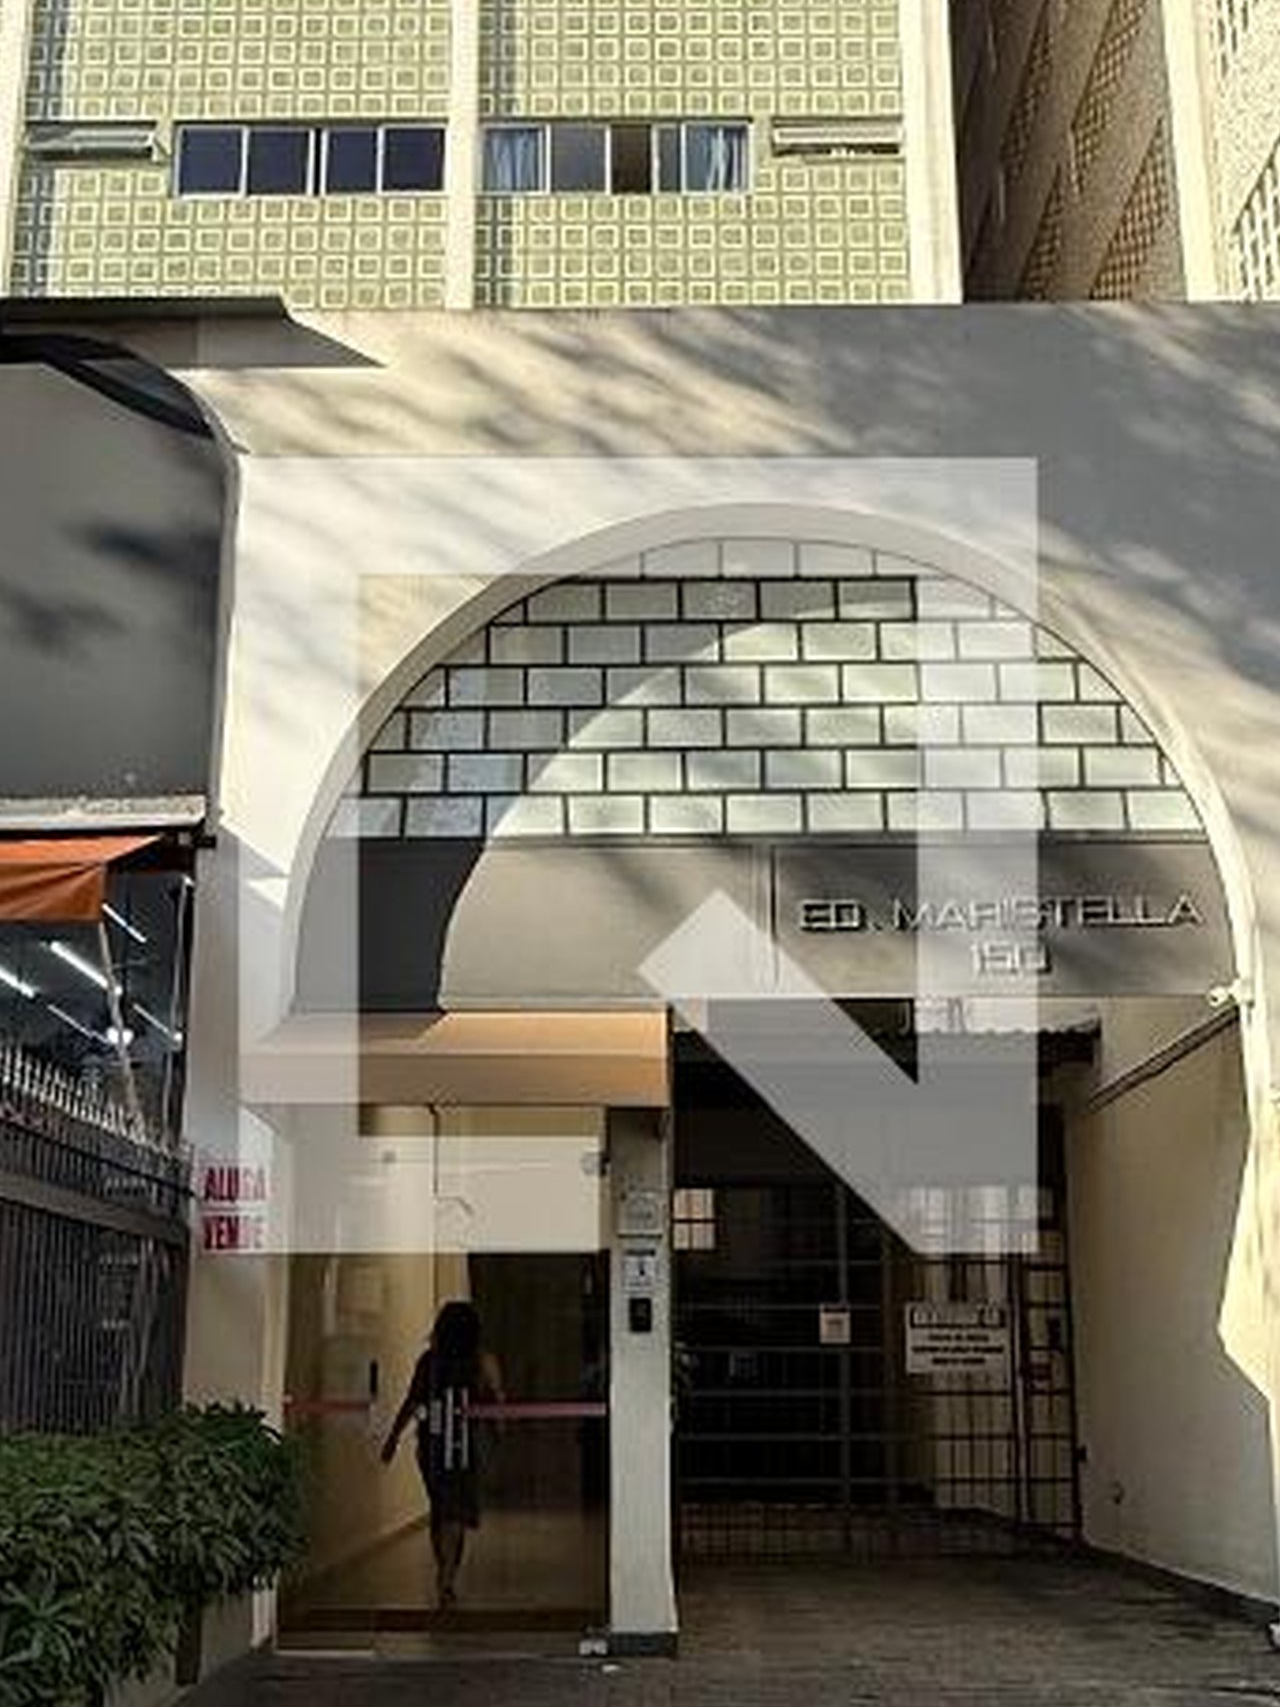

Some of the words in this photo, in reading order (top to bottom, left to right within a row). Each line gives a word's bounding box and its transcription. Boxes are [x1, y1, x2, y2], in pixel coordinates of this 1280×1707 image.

[892, 895, 1204, 932] MARISTELLA
[972, 940, 1053, 975] 150
[204, 1165, 266, 1202] ALUGA
[202, 1214, 265, 1250] VENDE
